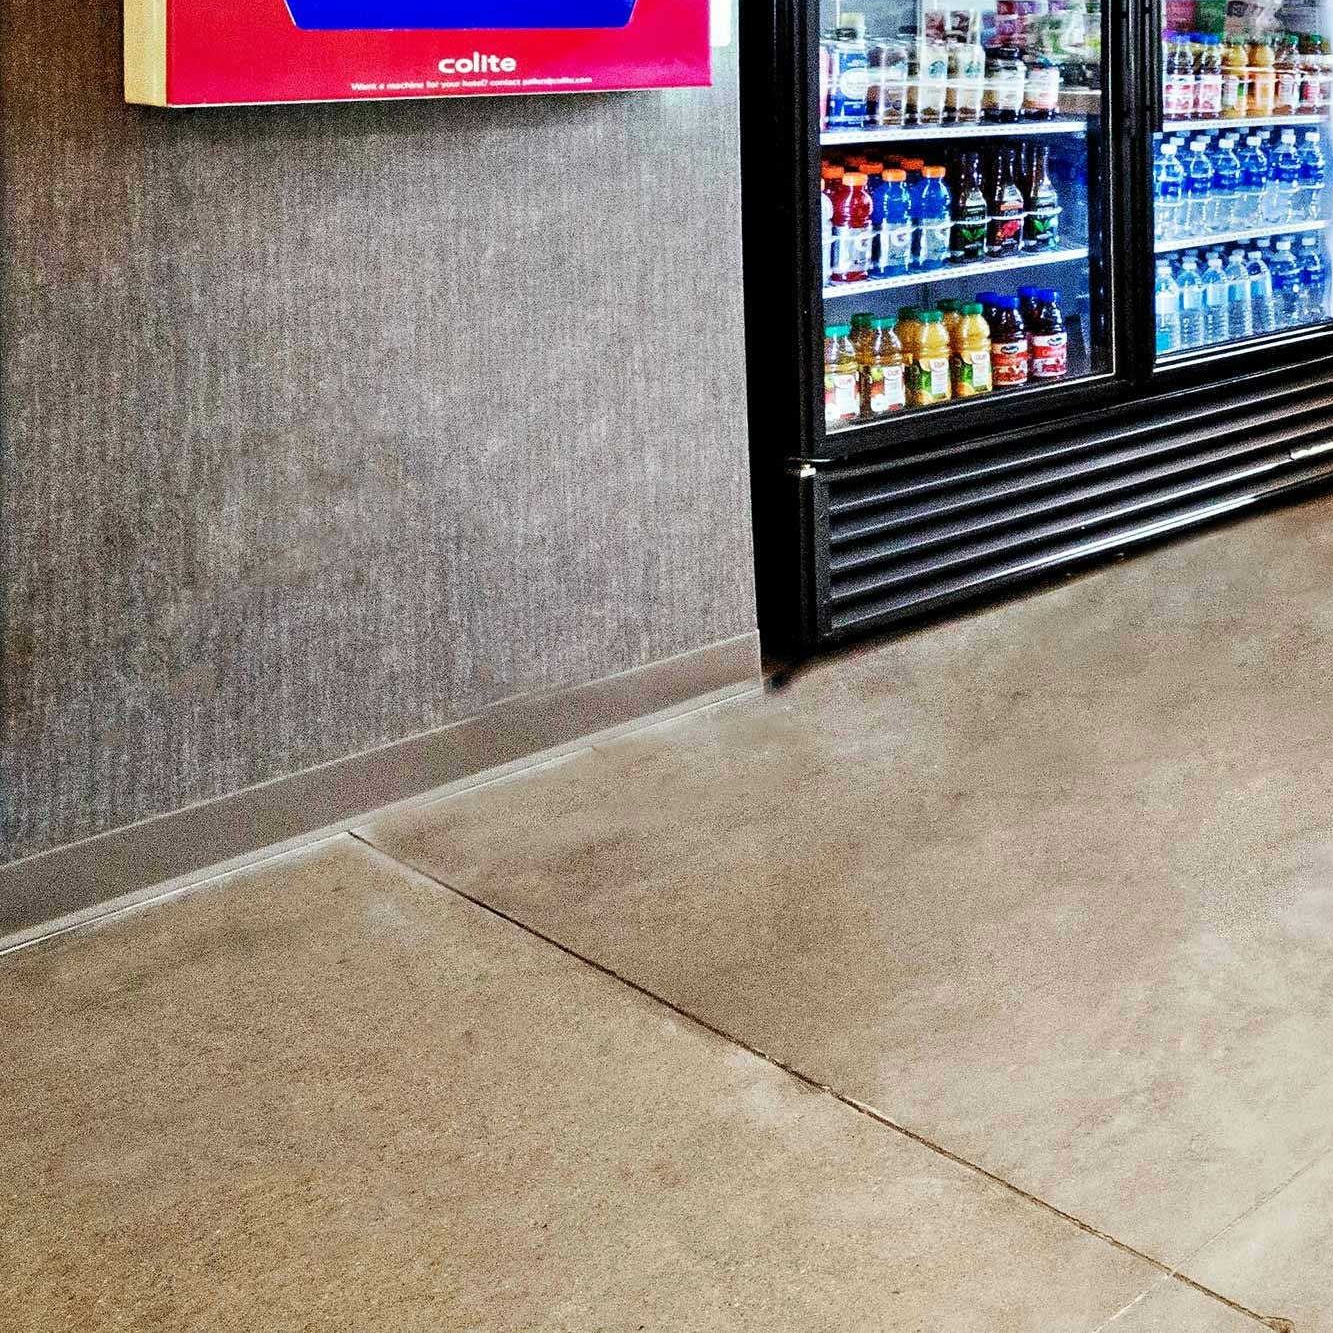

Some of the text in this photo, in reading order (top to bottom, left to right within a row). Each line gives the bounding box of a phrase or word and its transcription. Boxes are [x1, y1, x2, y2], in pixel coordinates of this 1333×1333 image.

[438, 51, 517, 74] colite
[351, 82, 378, 91] Want
[386, 81, 424, 90] machine
[426, 80, 439, 89] for
[440, 80, 460, 90] your
[462, 78, 487, 88] hotel?
[490, 78, 521, 87] contact
